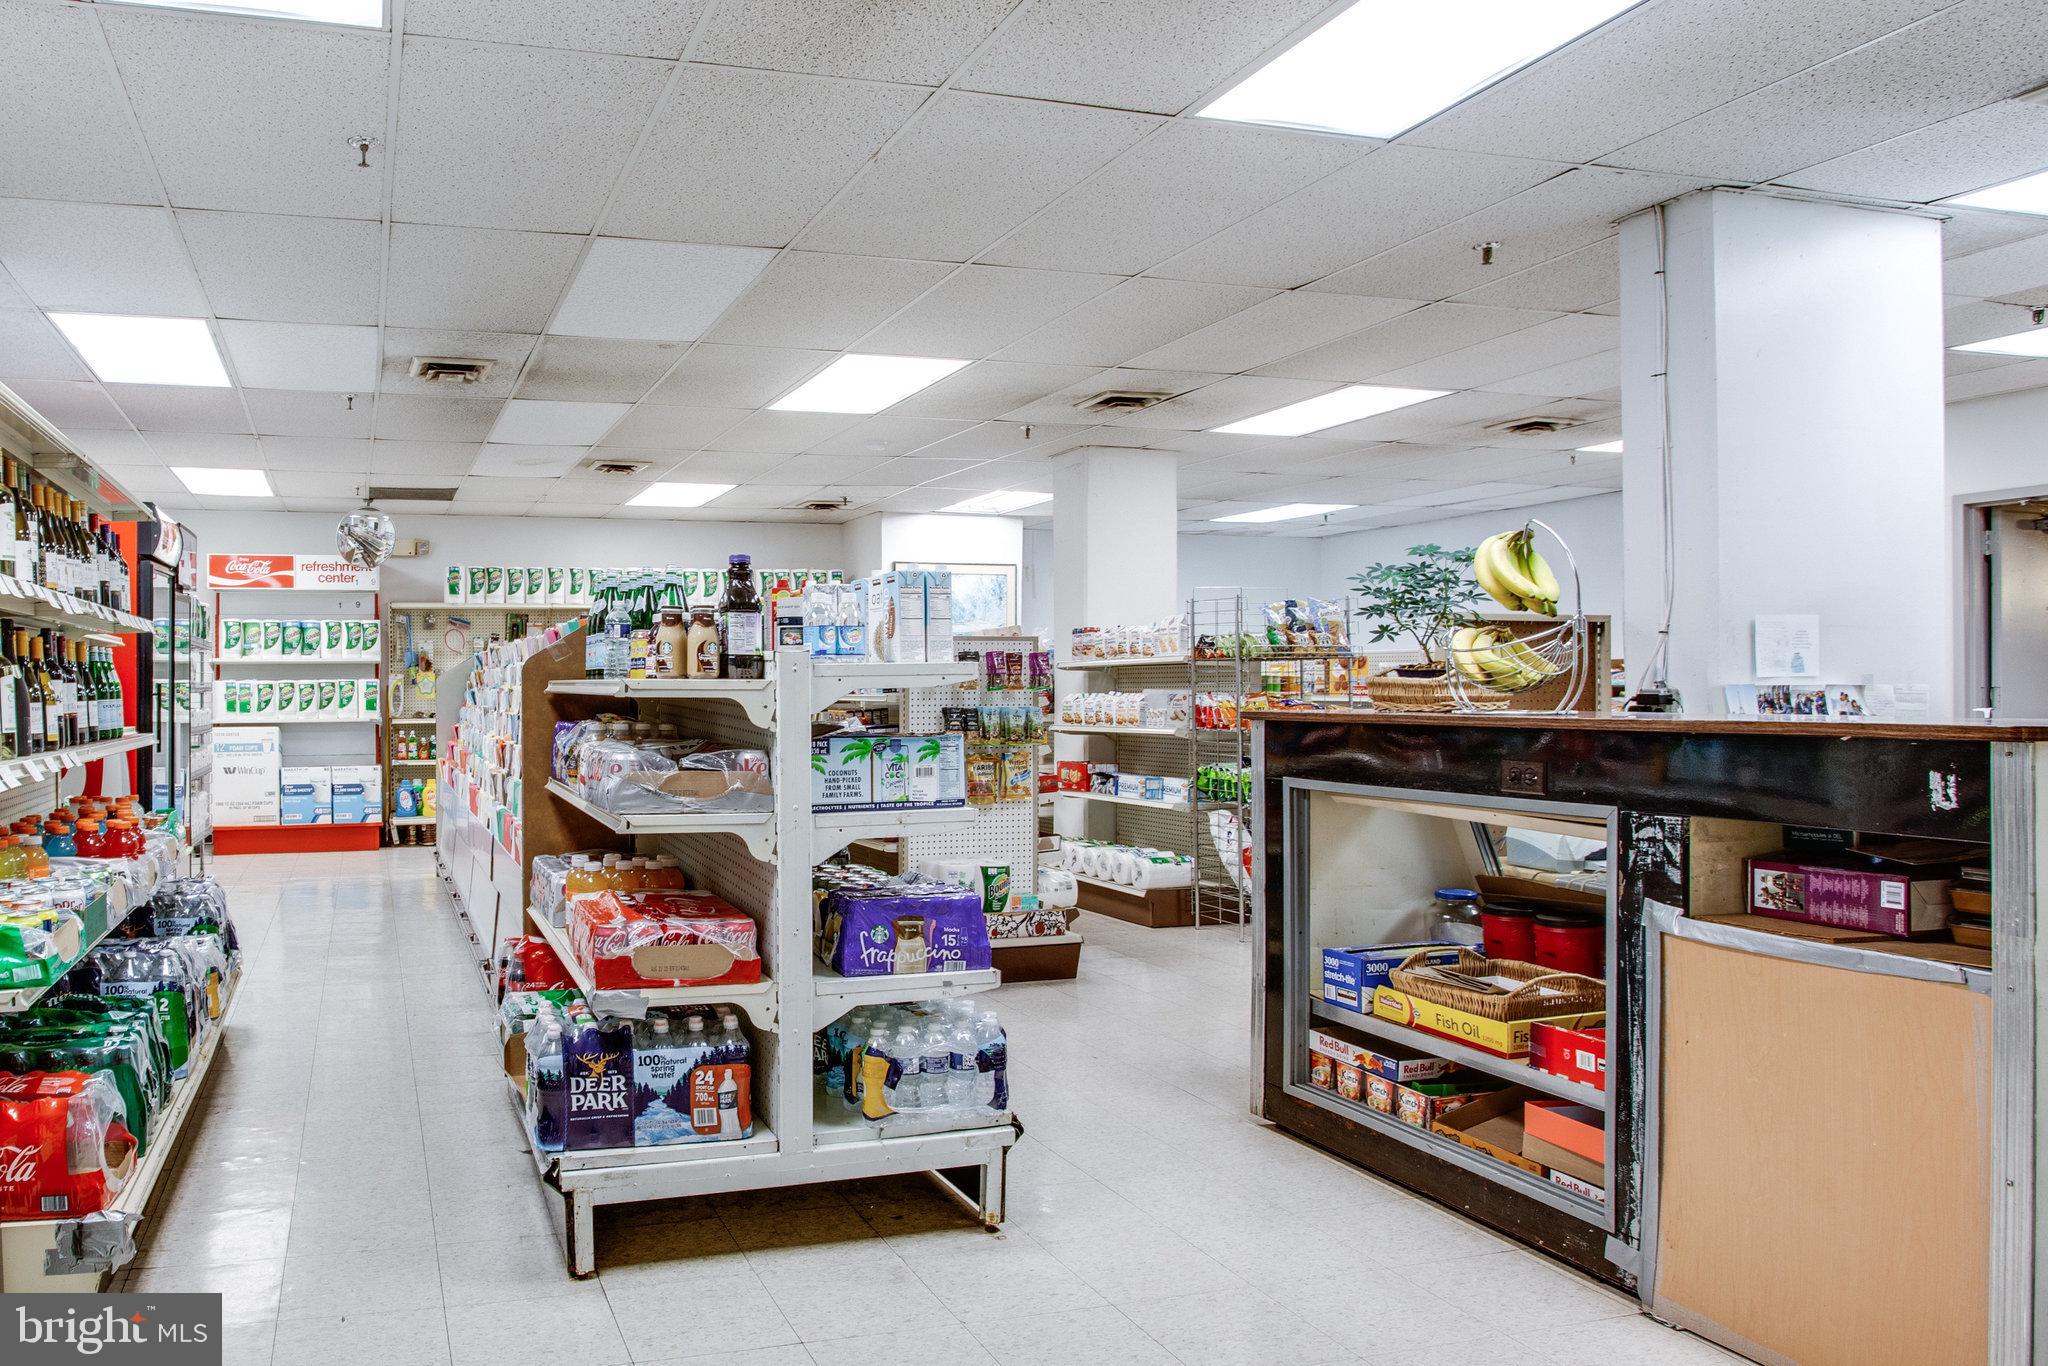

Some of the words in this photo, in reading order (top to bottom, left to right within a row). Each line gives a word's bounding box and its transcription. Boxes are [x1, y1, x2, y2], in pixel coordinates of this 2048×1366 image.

[225, 559, 273, 576] Coca-Cola
[318, 573, 356, 583] center
[237, 767, 265, 775] WinCup
[886, 762, 903, 771] VITA
[828, 769, 858, 777] COCONUTS
[824, 776, 862, 784] HAND-PICKED
[941, 934, 957, 946] 15
[860, 931, 961, 972] frappuccino
[1324, 956, 1339, 967] 3000
[1365, 962, 1389, 973] 3000
[159, 998, 169, 1012] 2
[1435, 1012, 1459, 1032] Fish
[1461, 1021, 1481, 1039] Oil
[1513, 1030, 1529, 1044] Fis
[1319, 1035, 1334, 1050] Red
[1334, 1041, 1349, 1054] Bull
[660, 1056, 687, 1066] natural
[651, 1065, 675, 1074] spring
[1403, 1065, 1419, 1074] Red
[1420, 1062, 1435, 1073] Bull
[695, 1070, 715, 1085] 24
[570, 1074, 628, 1094] DEER
[570, 1091, 629, 1112] PARK
[695, 1092, 708, 1102] 700
[0, 1144, 44, 1183] ola
[0, 1184, 15, 1192] STE
[1555, 1175, 1573, 1190] Red
[1573, 1183, 1590, 1197] Bull
